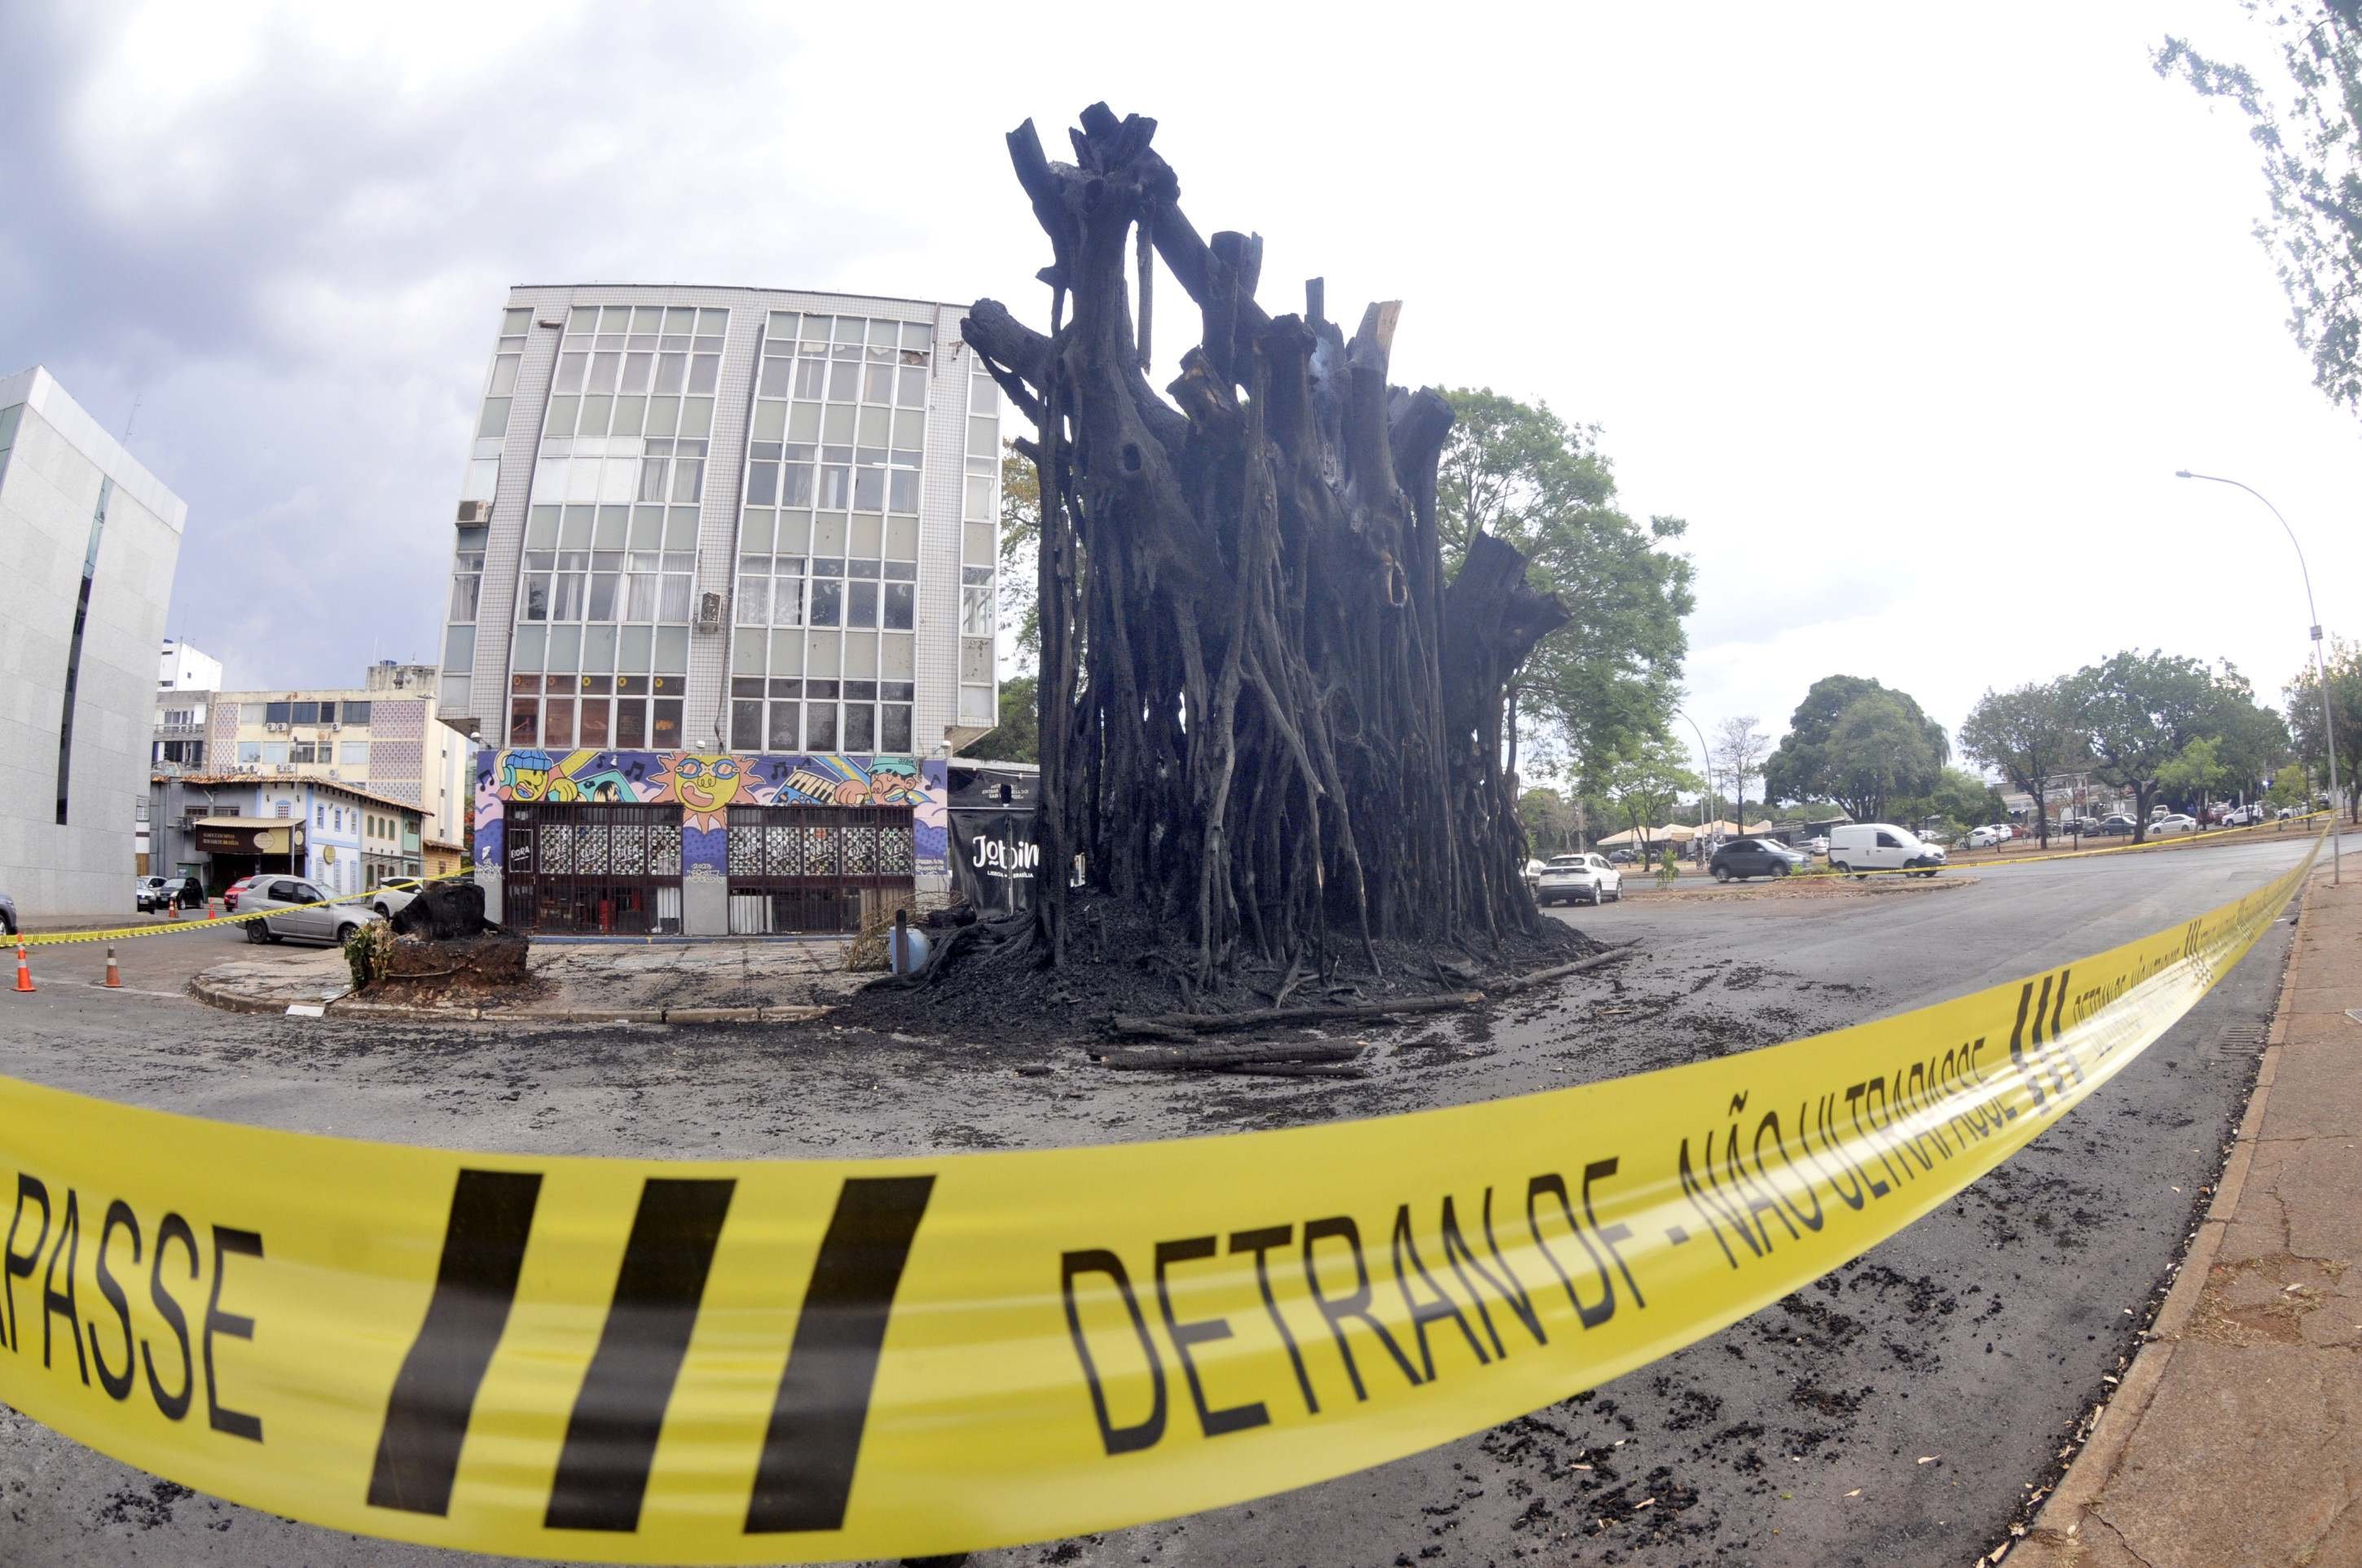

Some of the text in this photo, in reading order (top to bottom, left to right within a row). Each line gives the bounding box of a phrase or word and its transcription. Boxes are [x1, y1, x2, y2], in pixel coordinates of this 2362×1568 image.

[0, 1171, 264, 1444] PASSE
[1061, 1186, 1547, 1456] DETRAN
[1526, 1157, 1645, 1330] DF
[1678, 1090, 1824, 1269] NÃO
[1799, 1036, 2018, 1210] ULTRAPASSE
